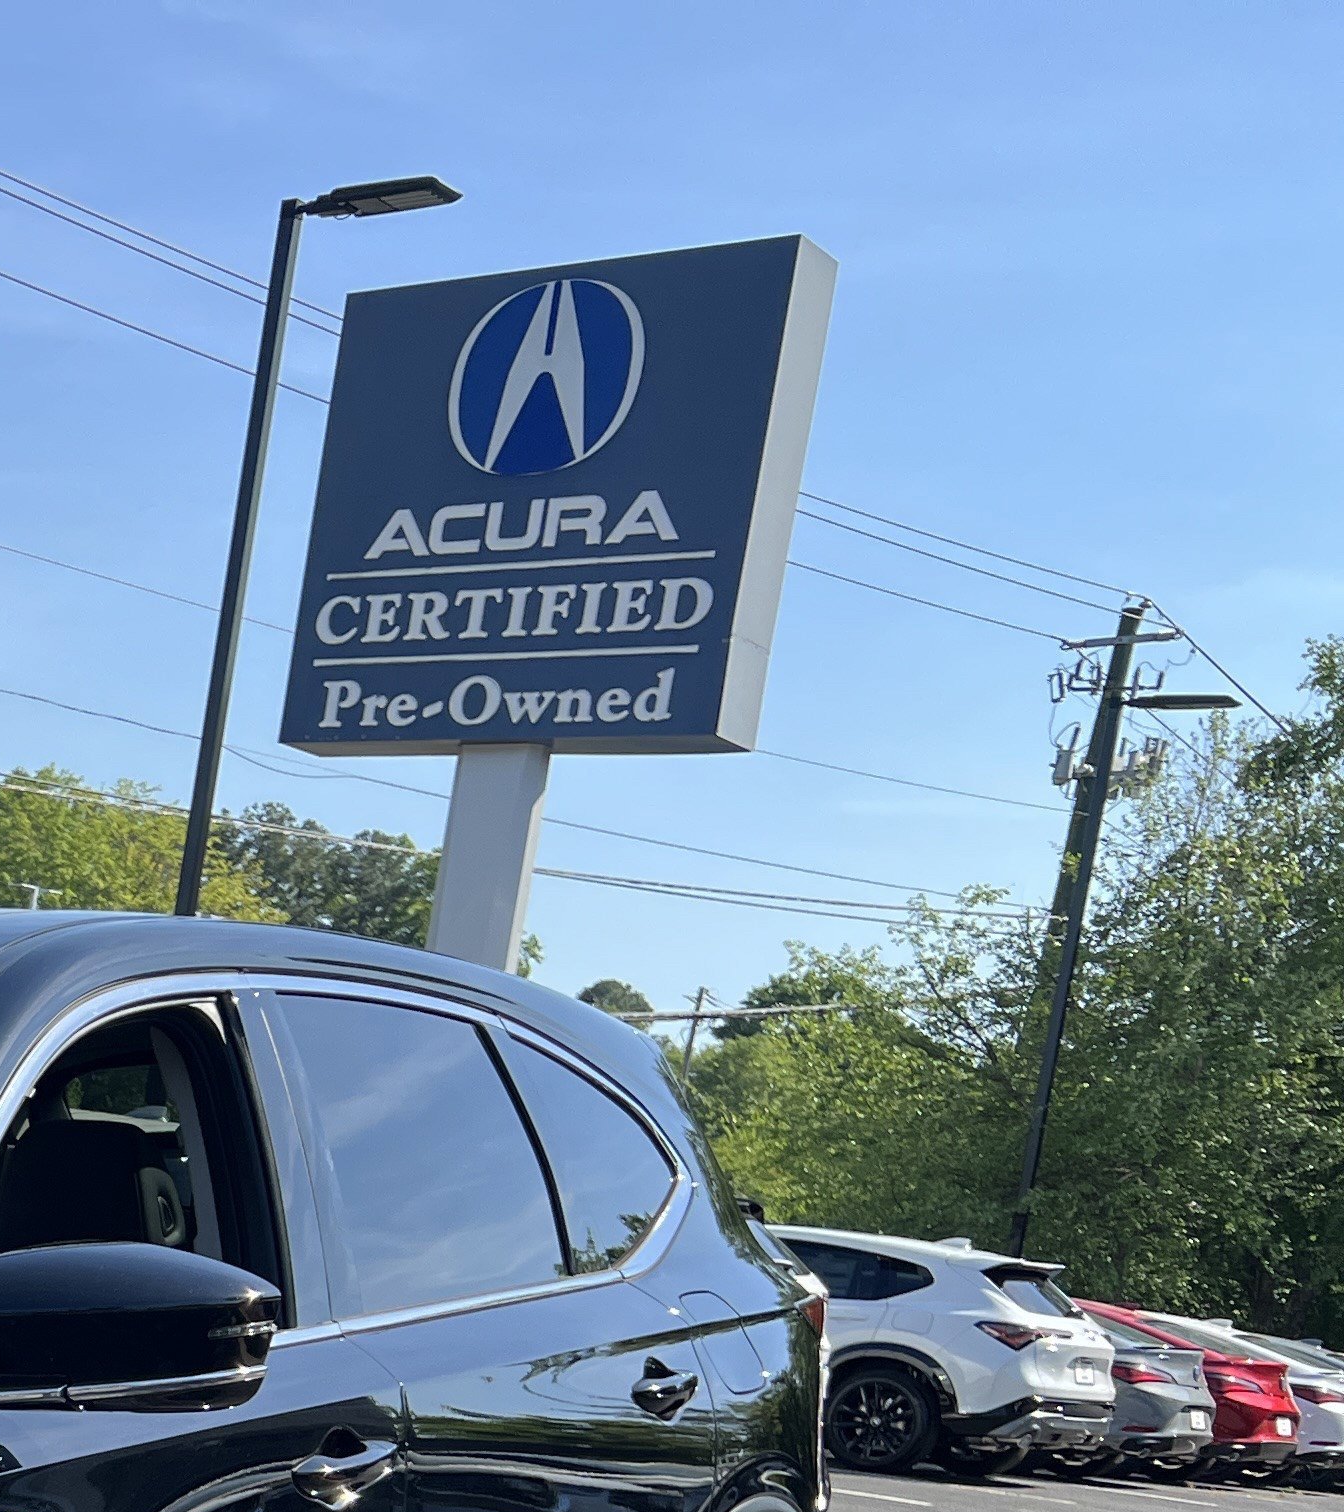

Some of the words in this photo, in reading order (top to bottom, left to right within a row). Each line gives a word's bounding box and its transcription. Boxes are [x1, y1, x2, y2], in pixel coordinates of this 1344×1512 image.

[363, 490, 679, 560] ACURA
[315, 576, 714, 645] CERTIFIED
[318, 667, 676, 730] Pre-Owned
